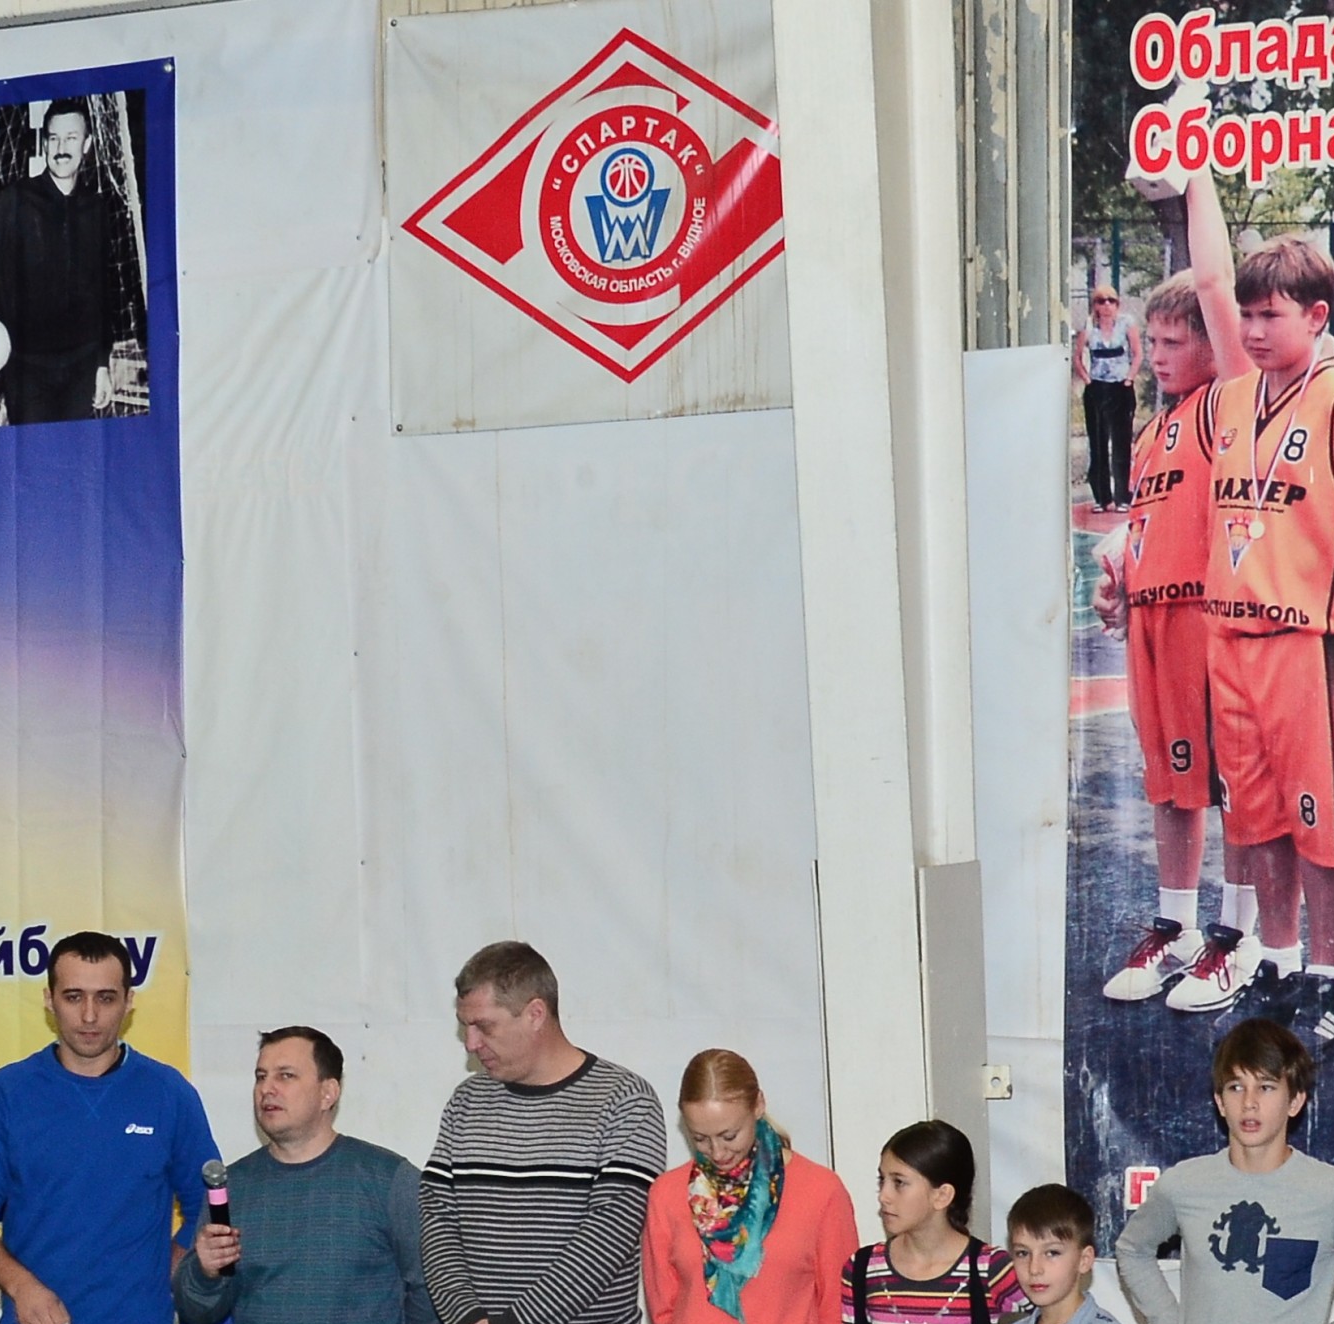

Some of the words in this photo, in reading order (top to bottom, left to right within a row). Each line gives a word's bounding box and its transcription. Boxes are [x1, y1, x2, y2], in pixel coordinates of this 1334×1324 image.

[549, 215, 608, 289] МОСКОВСКАЯ
[608, 265, 673, 293] ОБЛАСТЬ
[677, 196, 706, 259] ВИДНОЕ
[1165, 422, 1180, 451] 9
[1283, 429, 1307, 462] 8
[1170, 738, 1192, 773] 9
[1300, 793, 1316, 827] 8
